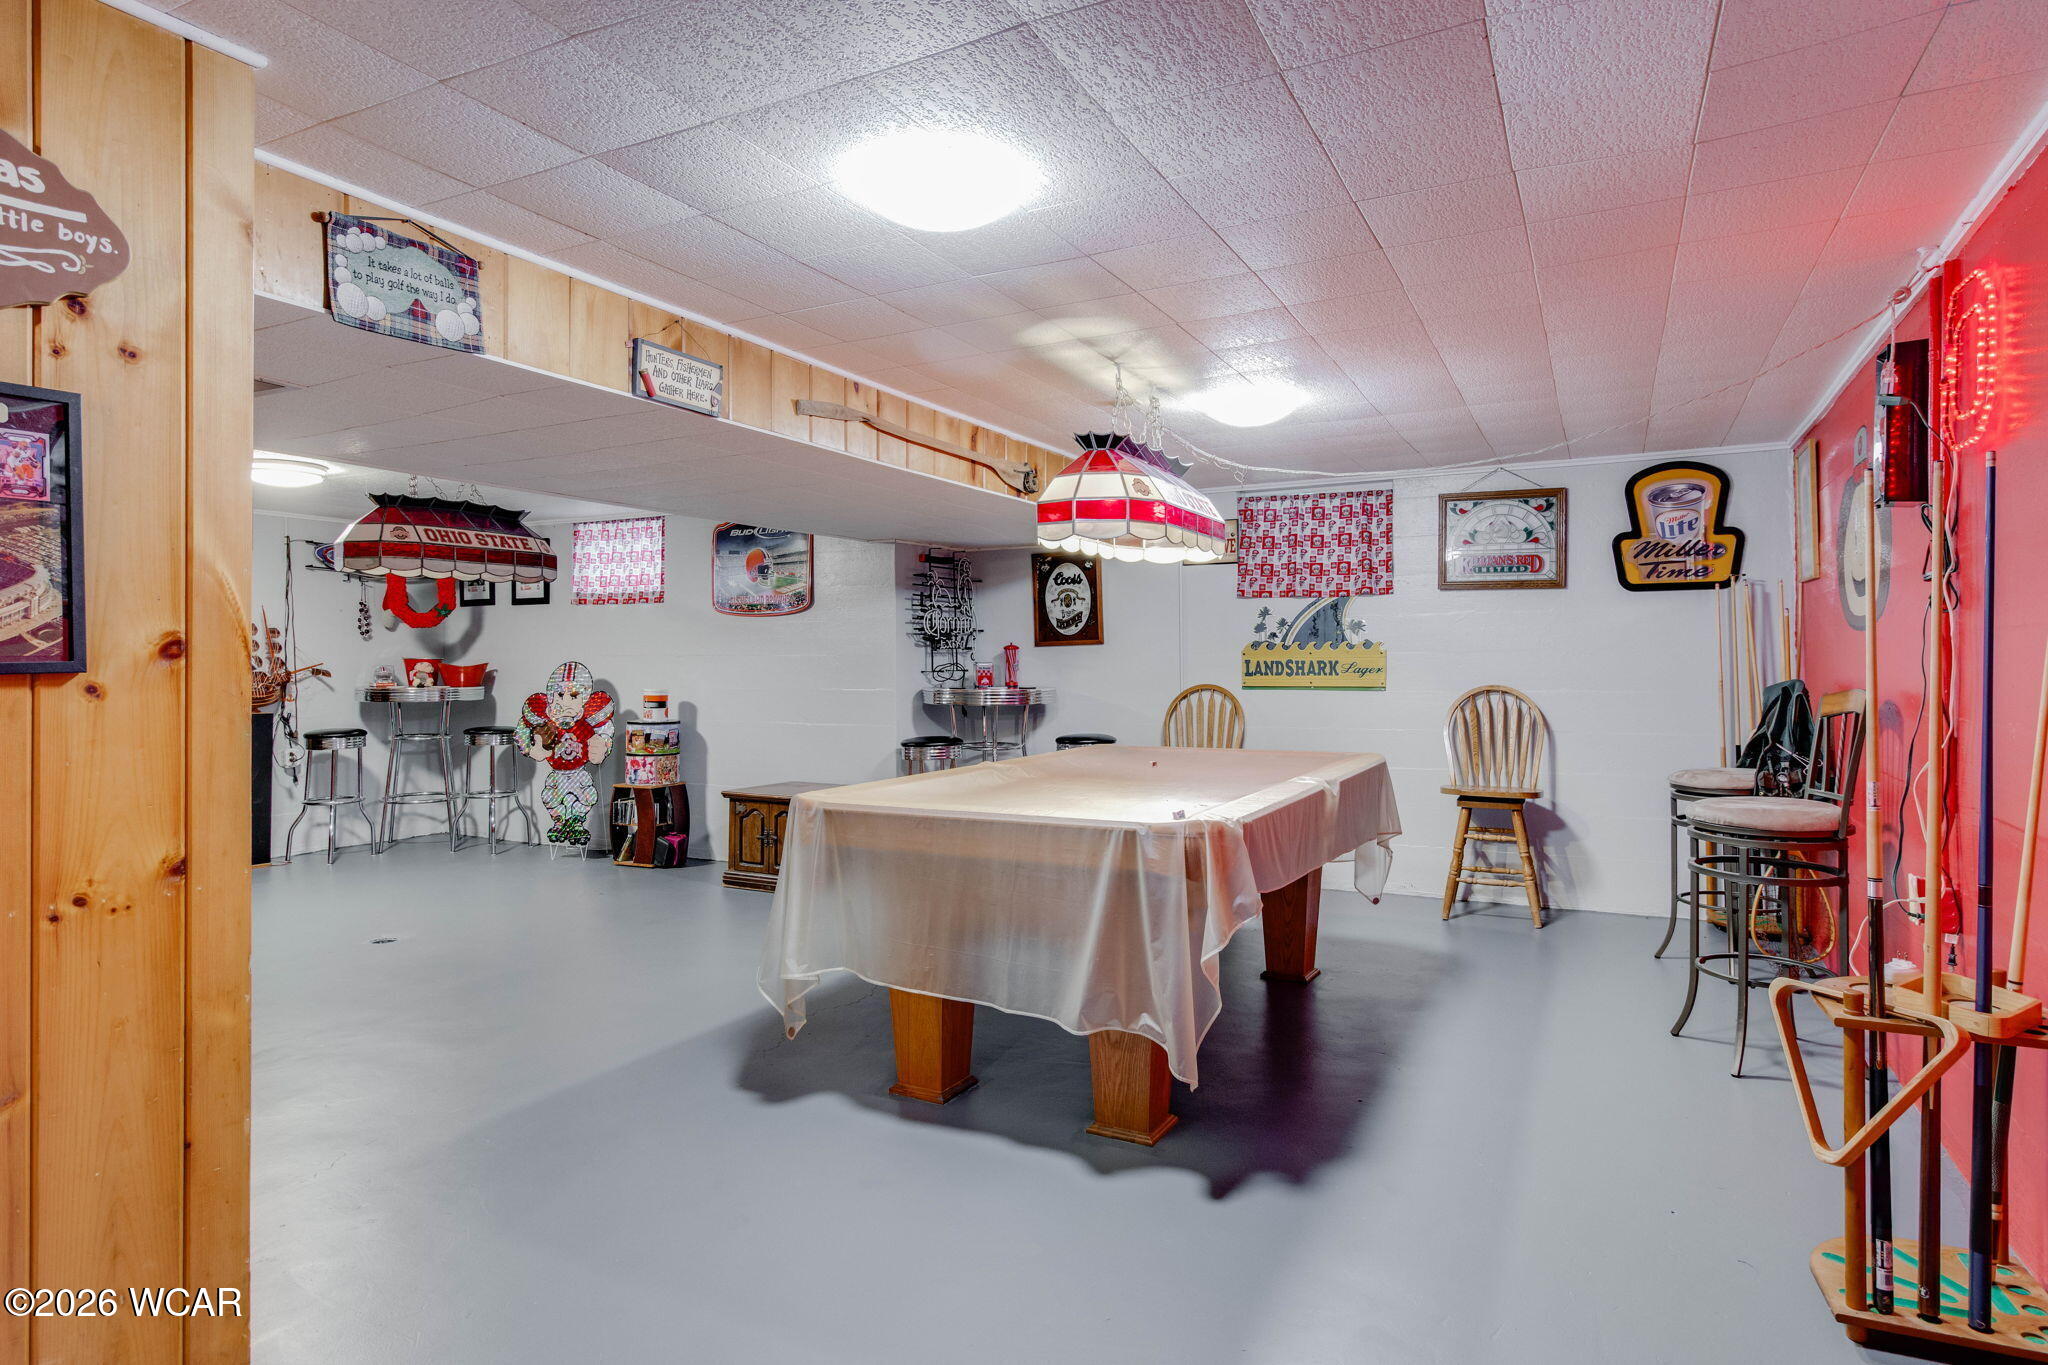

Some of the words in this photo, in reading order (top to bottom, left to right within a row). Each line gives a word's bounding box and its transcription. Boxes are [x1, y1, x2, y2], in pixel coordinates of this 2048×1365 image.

[58, 222, 119, 255] boys.
[367, 255, 376, 269] It
[378, 261, 402, 275] takes
[403, 269, 409, 278] a
[410, 267, 422, 281] lot
[423, 273, 433, 284] of
[434, 275, 455, 290] balls
[352, 268, 363, 280] to
[365, 271, 385, 288] play
[387, 278, 404, 291] golf
[406, 282, 420, 295] the
[421, 288, 438, 303] way
[445, 293, 456, 305] do
[652, 364, 668, 379] AND
[671, 371, 693, 388] OTHER
[695, 376, 715, 392] LIARS
[658, 381, 684, 399] GATHER
[424, 527, 472, 546] OHIO
[477, 533, 534, 551] STATE
[729, 527, 755, 537] BUD
[1633, 539, 1727, 559] Miller
[1052, 571, 1084, 587] Coors
[1638, 560, 1714, 579] Time
[1340, 661, 1384, 679] Lager
